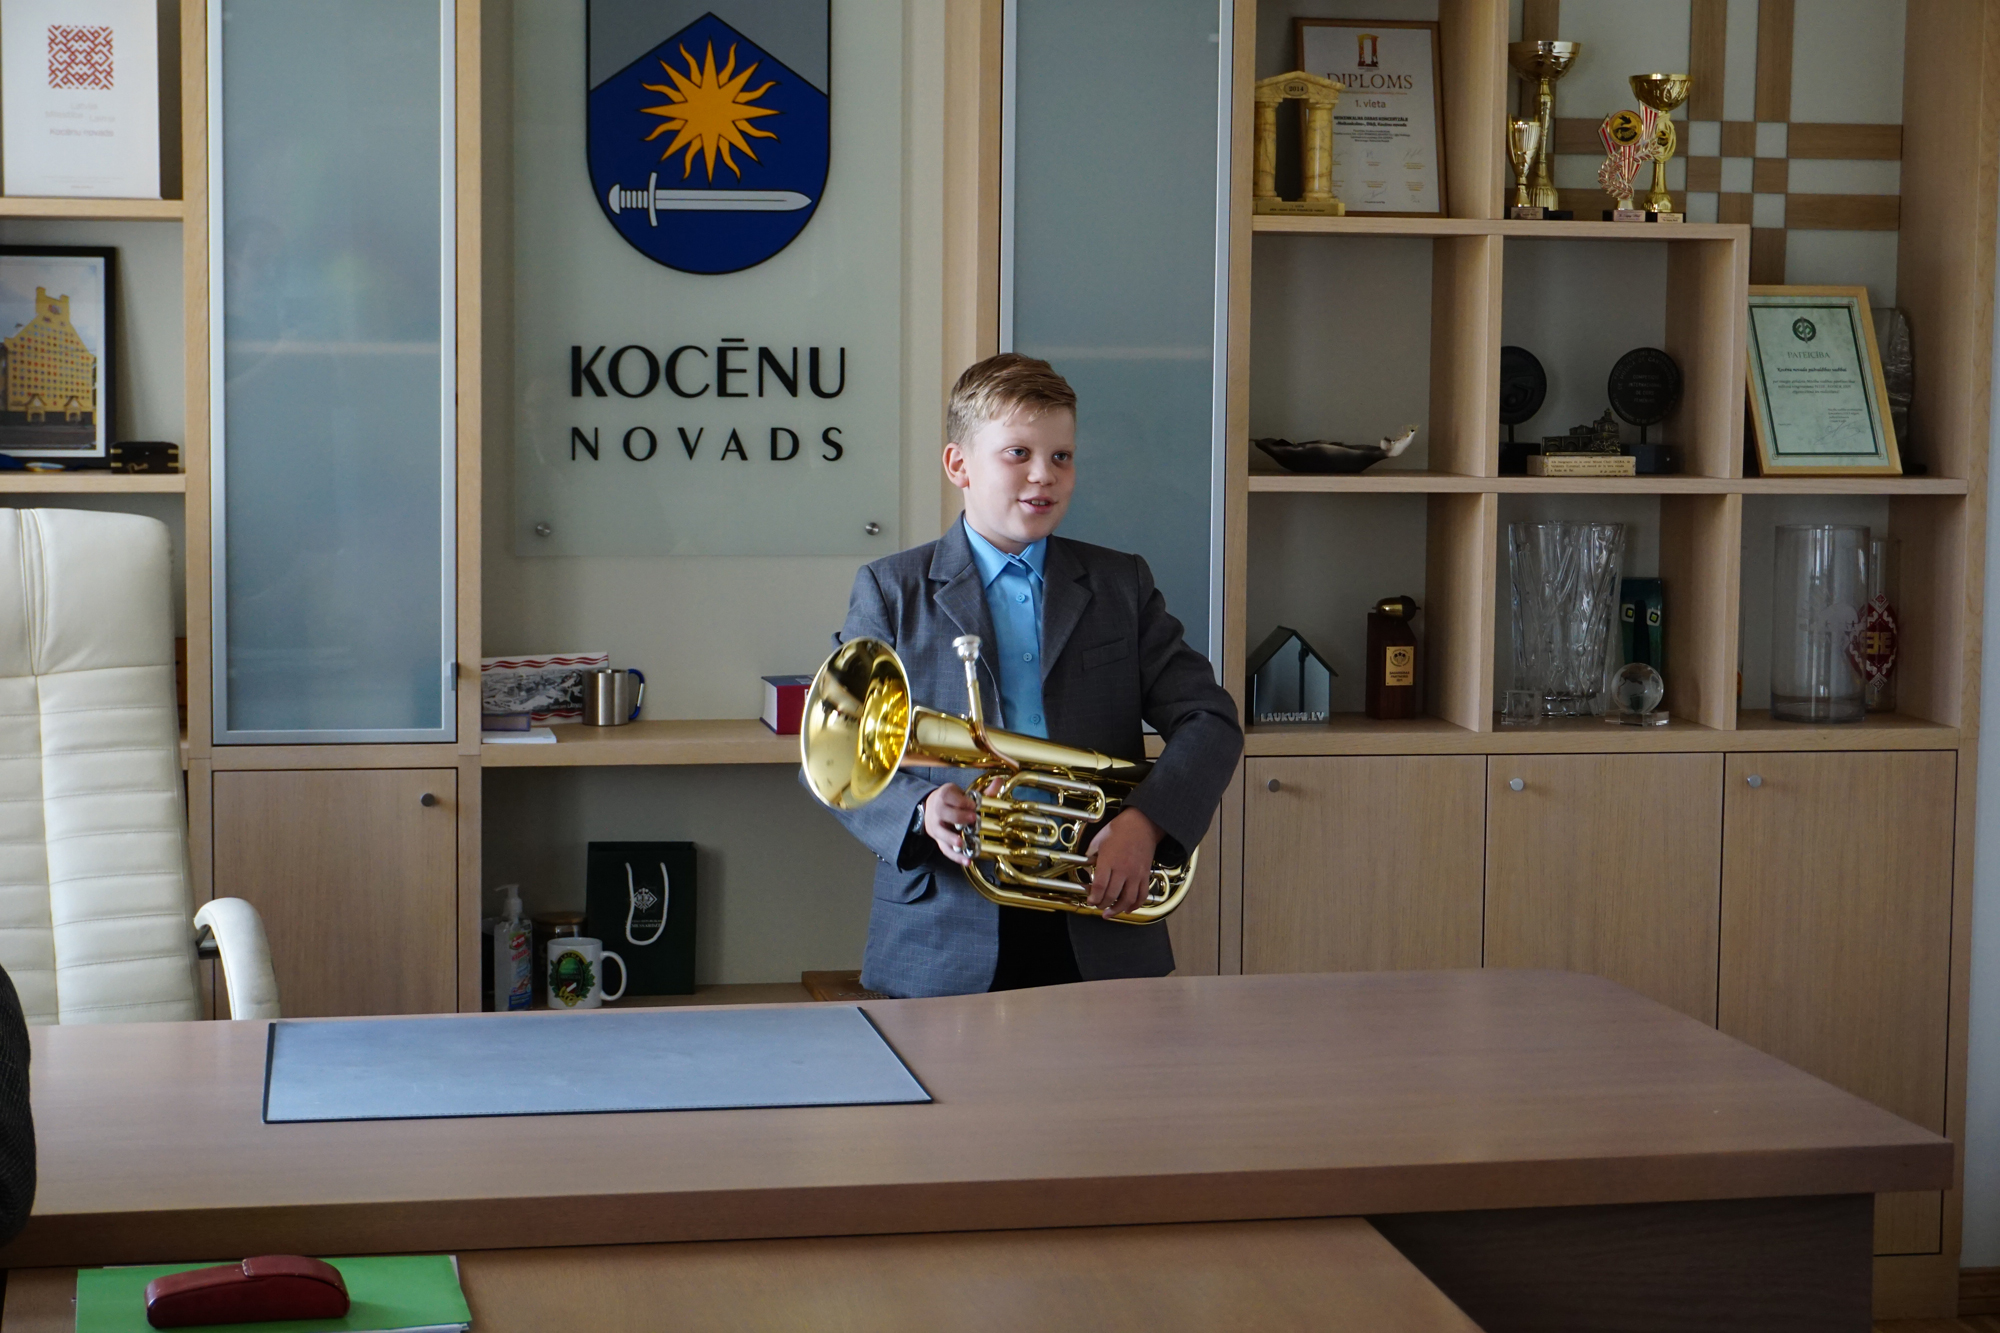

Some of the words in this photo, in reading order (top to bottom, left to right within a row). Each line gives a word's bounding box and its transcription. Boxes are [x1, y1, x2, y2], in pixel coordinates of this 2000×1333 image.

[1327, 73, 1413, 89] DIPLOMS
[1355, 99, 1362, 108] 1.
[1363, 99, 1386, 108] vieta
[1787, 351, 1831, 359] PATEICĪBA
[571, 338, 845, 399] KOCĒNU
[571, 426, 844, 462] NOVADS
[1260, 711, 1324, 722] LAUKUMI.LV
